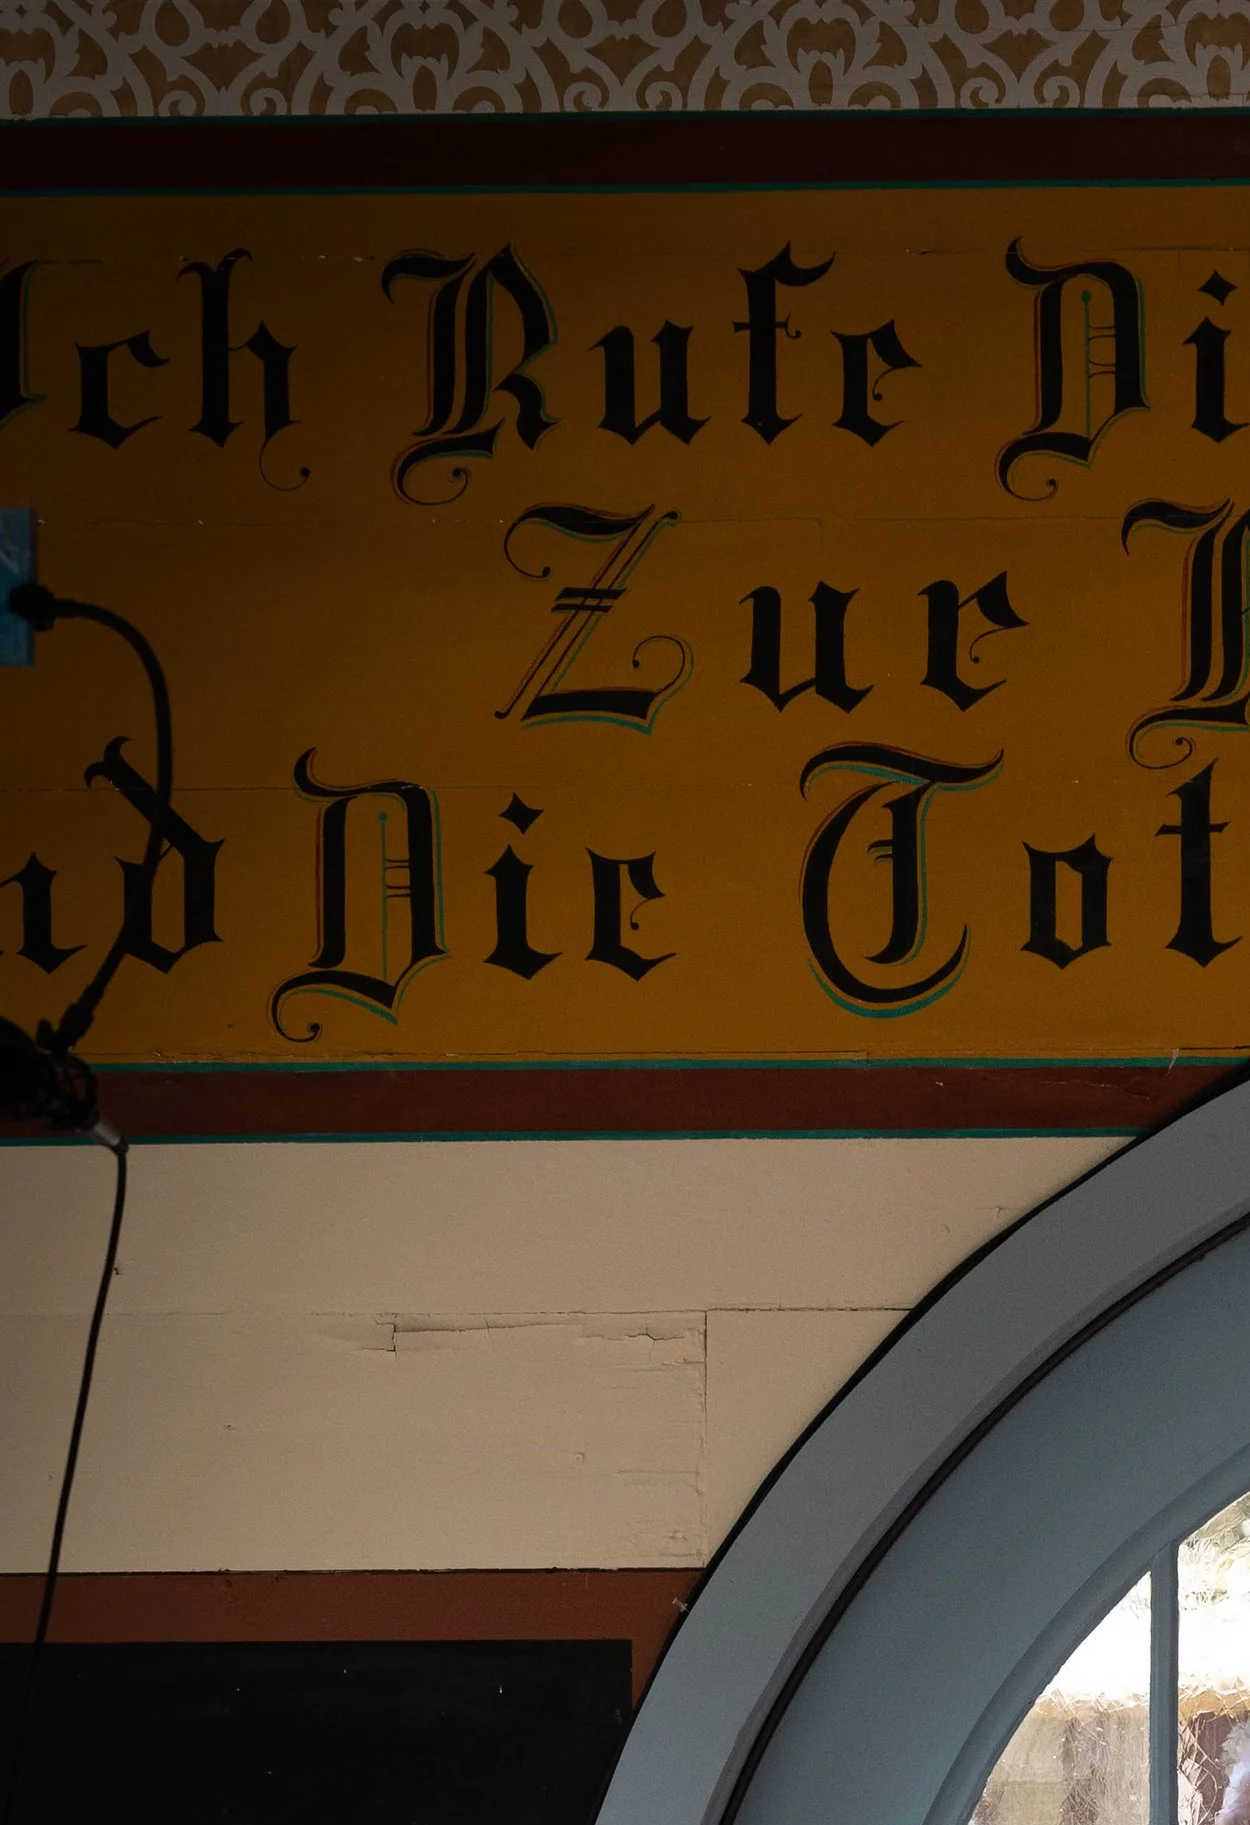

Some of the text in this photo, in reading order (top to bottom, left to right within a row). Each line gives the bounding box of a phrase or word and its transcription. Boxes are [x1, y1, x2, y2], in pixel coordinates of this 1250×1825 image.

[380, 240, 922, 505] Rufe
[495, 503, 1030, 734] Zur
[271, 748, 676, 1041] Die
